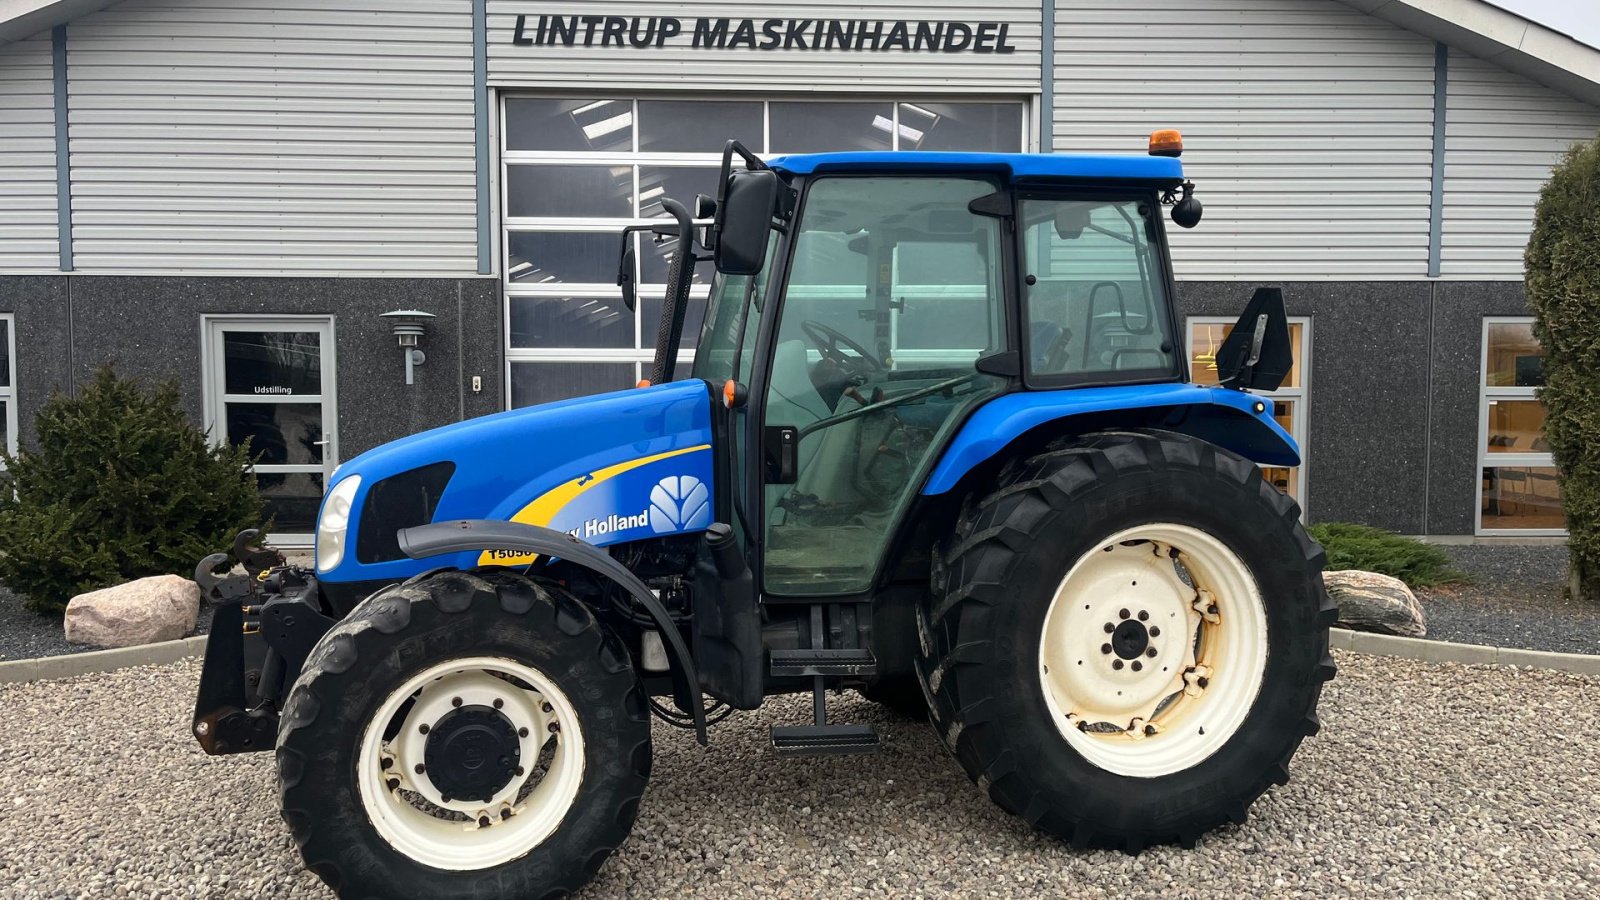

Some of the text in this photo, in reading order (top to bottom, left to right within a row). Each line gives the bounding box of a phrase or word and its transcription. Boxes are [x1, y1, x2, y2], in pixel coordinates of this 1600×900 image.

[512, 14, 1016, 54] LINTRUP MASKINHANDEL
[254, 385, 292, 395] Udstilling
[584, 509, 649, 538] Holland
